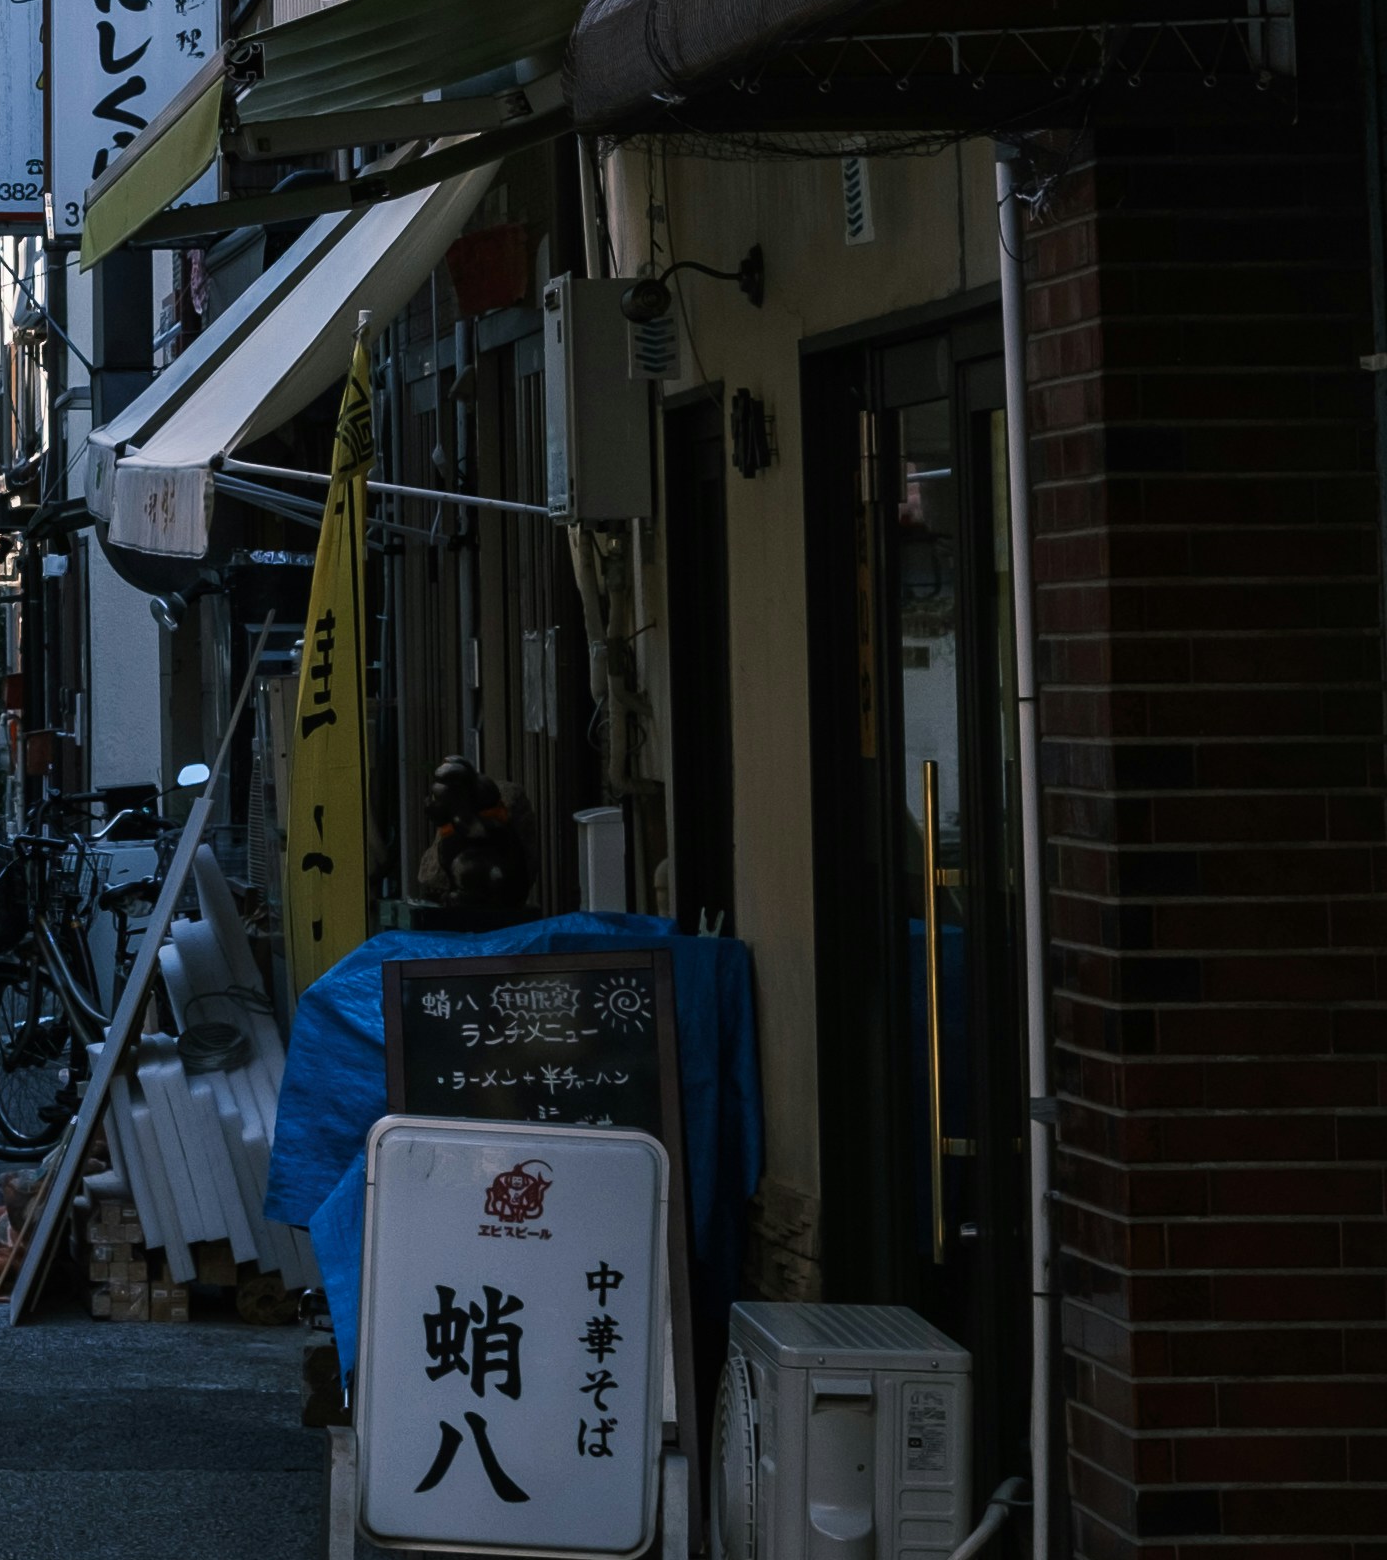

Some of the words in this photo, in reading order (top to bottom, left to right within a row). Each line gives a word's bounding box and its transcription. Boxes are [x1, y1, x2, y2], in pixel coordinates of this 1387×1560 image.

[422, 989, 479, 1020] 蛸八
[461, 1020, 598, 1047] ランチメニュー
[414, 1284, 531, 1504] 蛸八
[577, 1260, 625, 1458] 中華そば
